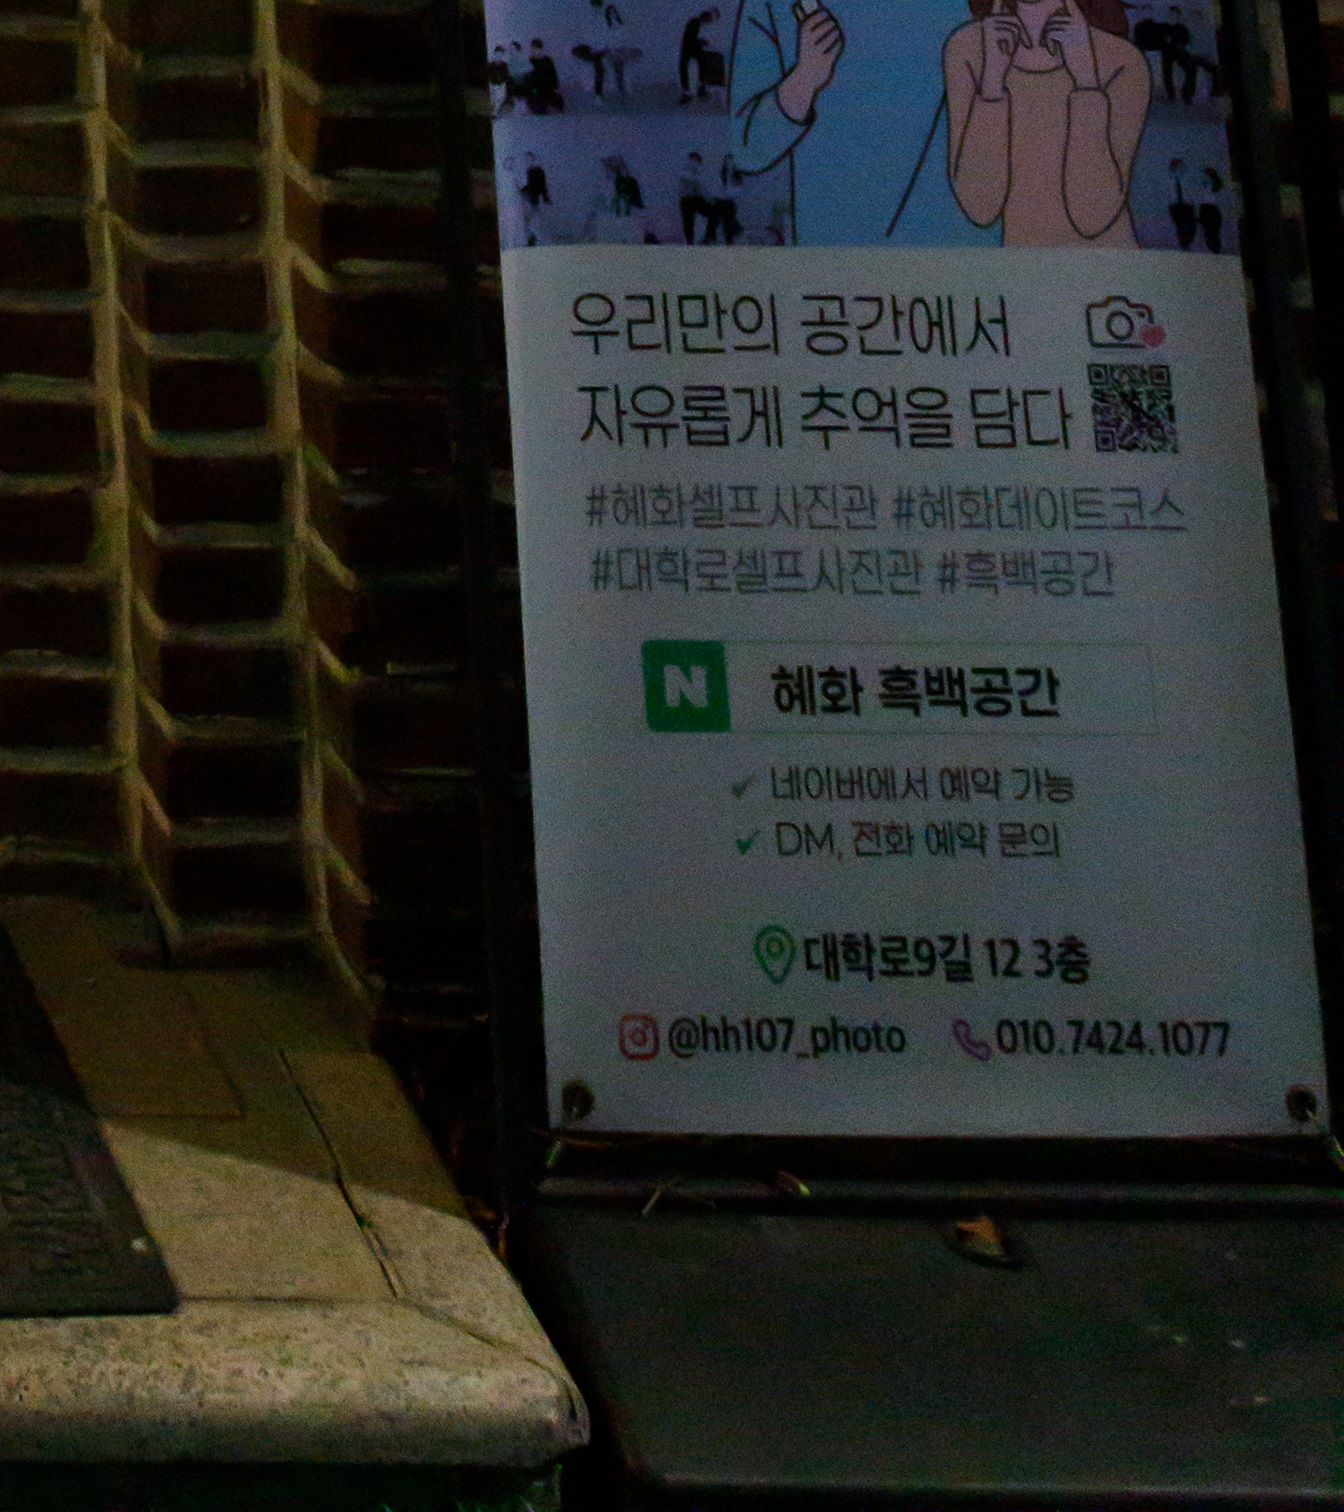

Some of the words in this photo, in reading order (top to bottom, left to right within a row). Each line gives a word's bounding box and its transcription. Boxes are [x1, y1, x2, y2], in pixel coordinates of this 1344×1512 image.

[571, 291, 781, 356] 우리만의
[801, 293, 1011, 358] 공간에서
[577, 384, 785, 450] 자유롭게
[800, 384, 955, 451] 추억을
[970, 386, 1073, 451] 담다
[590, 546, 923, 597] #대학로셀프사진관
[936, 549, 1117, 598] #흑백공간
[664, 664, 709, 707] N
[771, 664, 864, 716] 혜화
[877, 665, 1062, 718] 흑백공간
[770, 766, 930, 802] 네이버에서
[939, 766, 1002, 802] 예약
[1013, 766, 1076, 804] 가능
[774, 822, 843, 861] DM,
[850, 820, 914, 857] 전화
[923, 821, 989, 858] 예약
[996, 821, 1063, 859] 문의
[803, 932, 975, 984] 대학로9길
[986, 937, 1021, 980] 12
[1033, 934, 1091, 984] 3층
[667, 1016, 907, 1061] @hh107_photo
[996, 1019, 1232, 1058] 010.7424.1077
